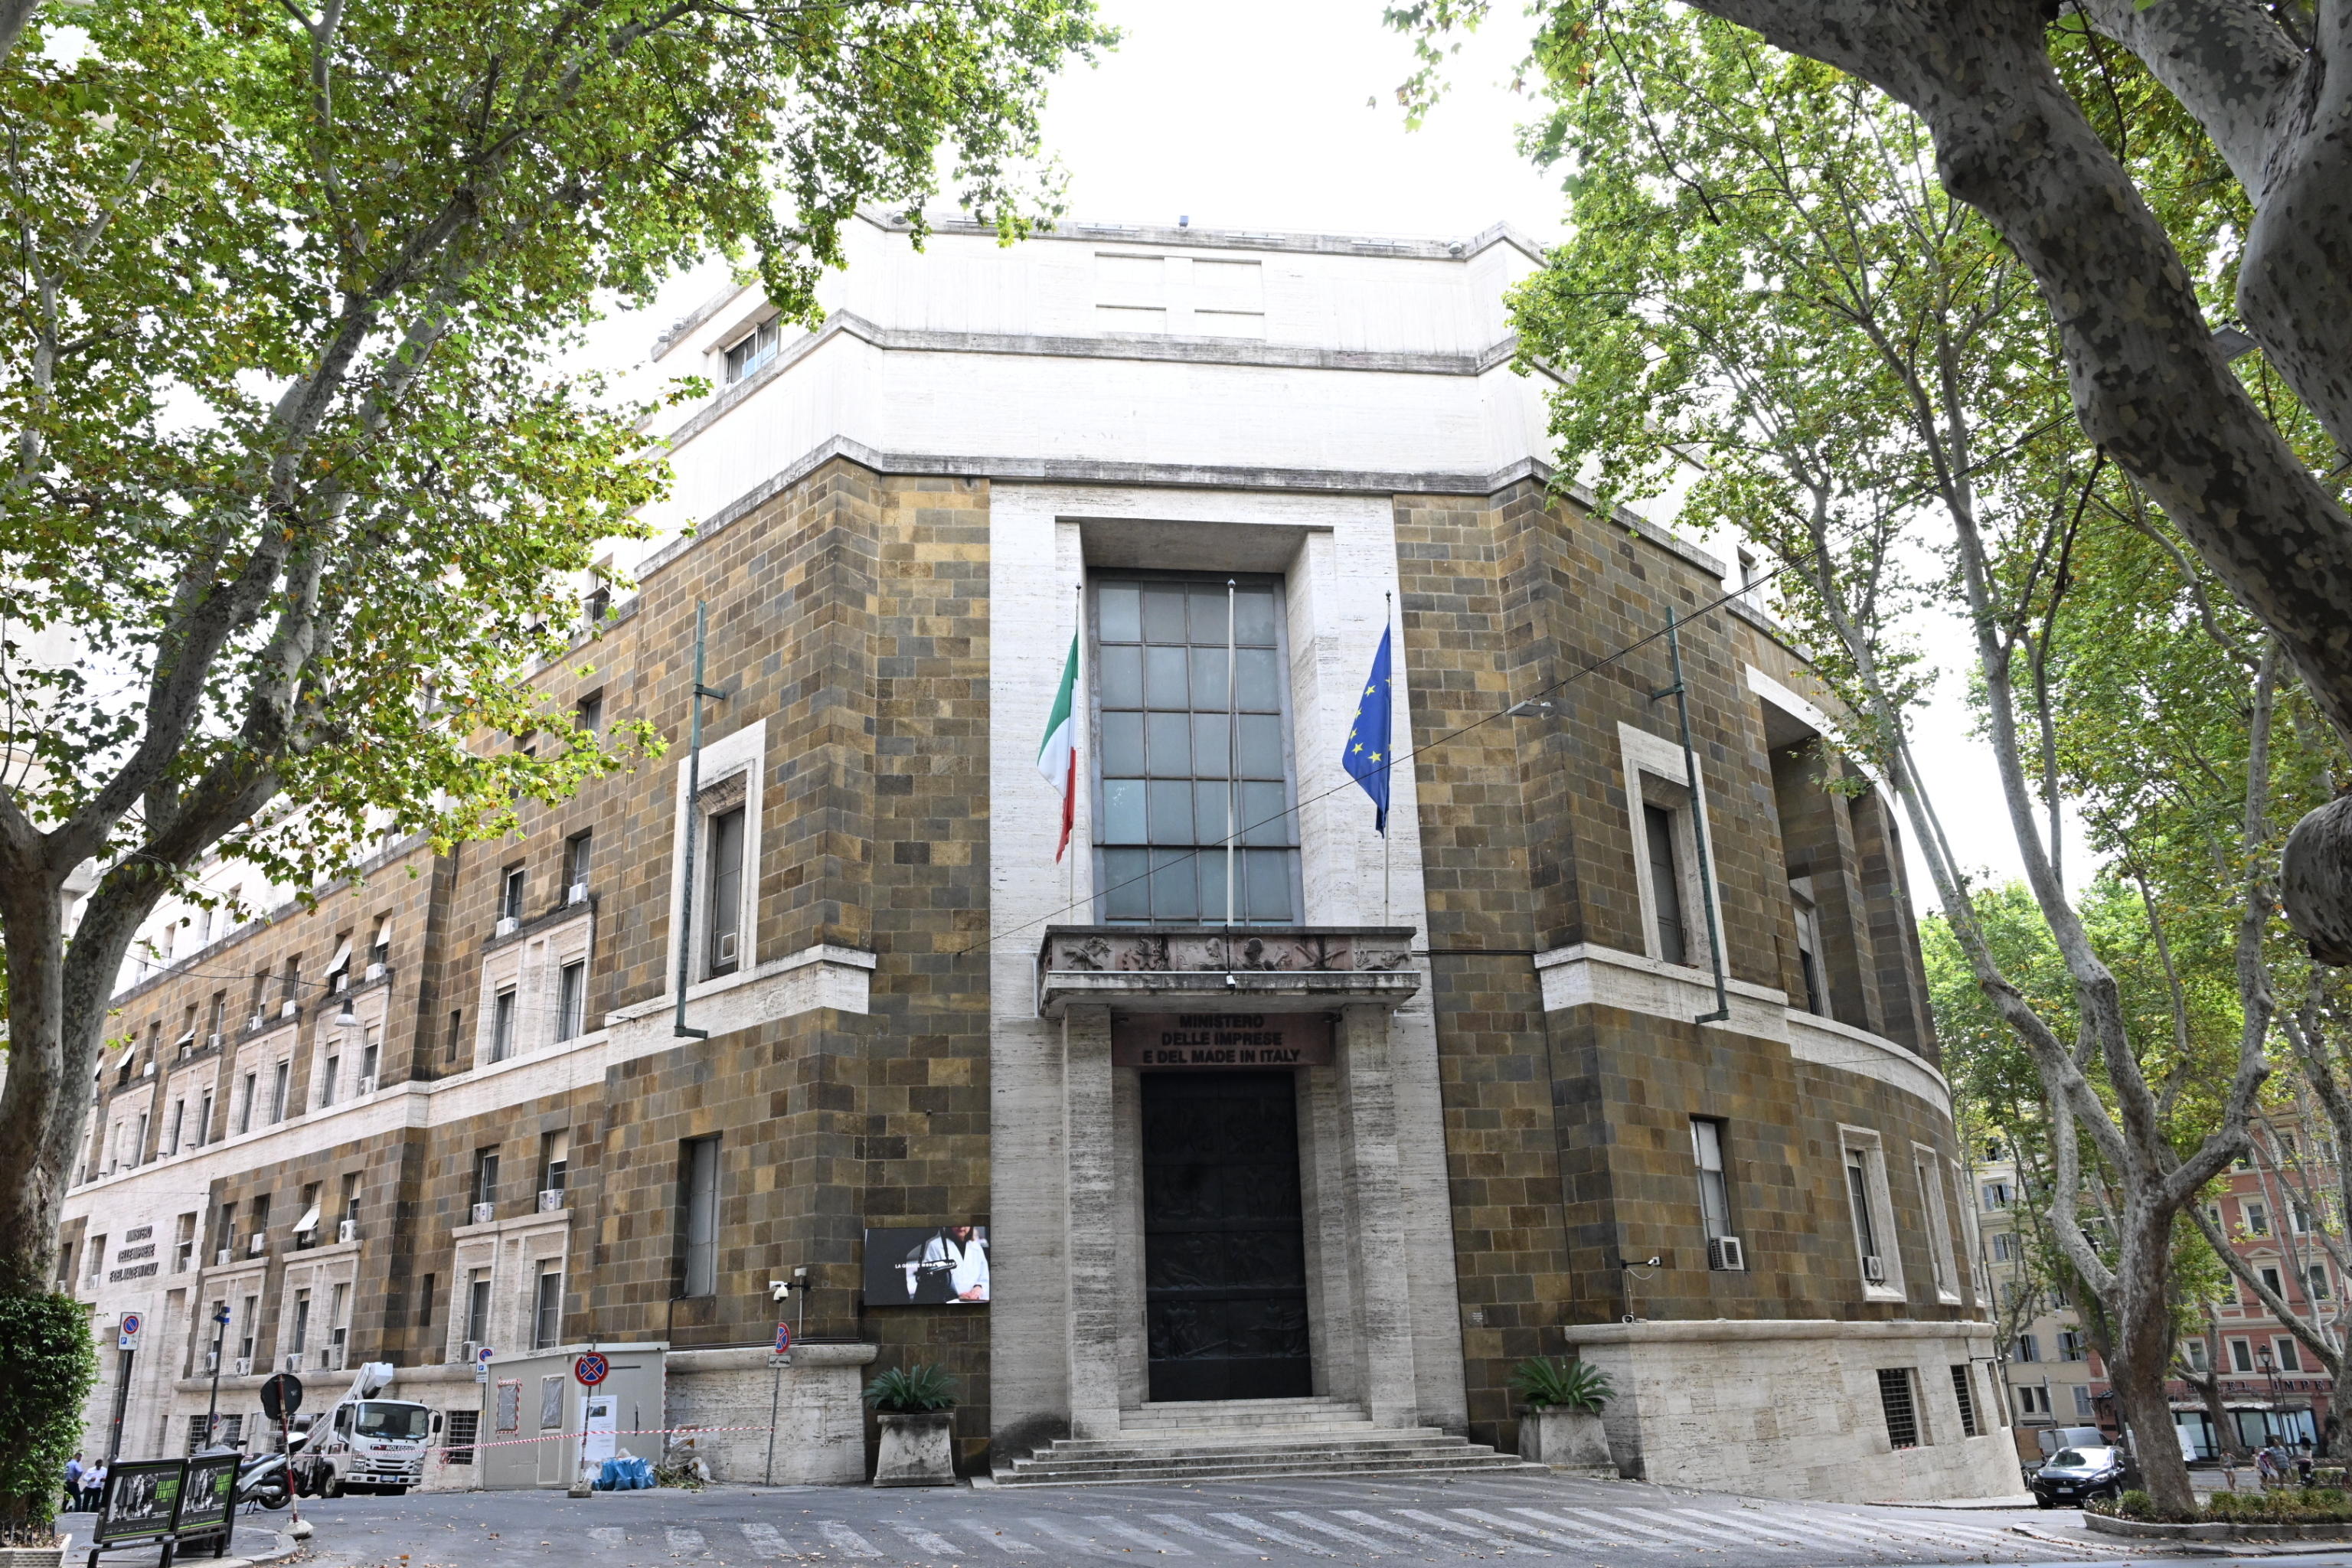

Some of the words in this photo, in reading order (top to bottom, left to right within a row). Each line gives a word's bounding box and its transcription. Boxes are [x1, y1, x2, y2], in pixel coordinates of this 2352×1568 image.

[1179, 1014, 1264, 1027] MINISTERO
[1161, 1032, 1210, 1045] DELLE
[1214, 1032, 1282, 1045] IMPRESE
[1143, 1050, 1153, 1063] E
[1157, 1050, 1187, 1063] DEL
[1191, 1050, 1236, 1063] MADE
[1240, 1050, 1256, 1063] IN
[1260, 1050, 1301, 1063] ITALY
